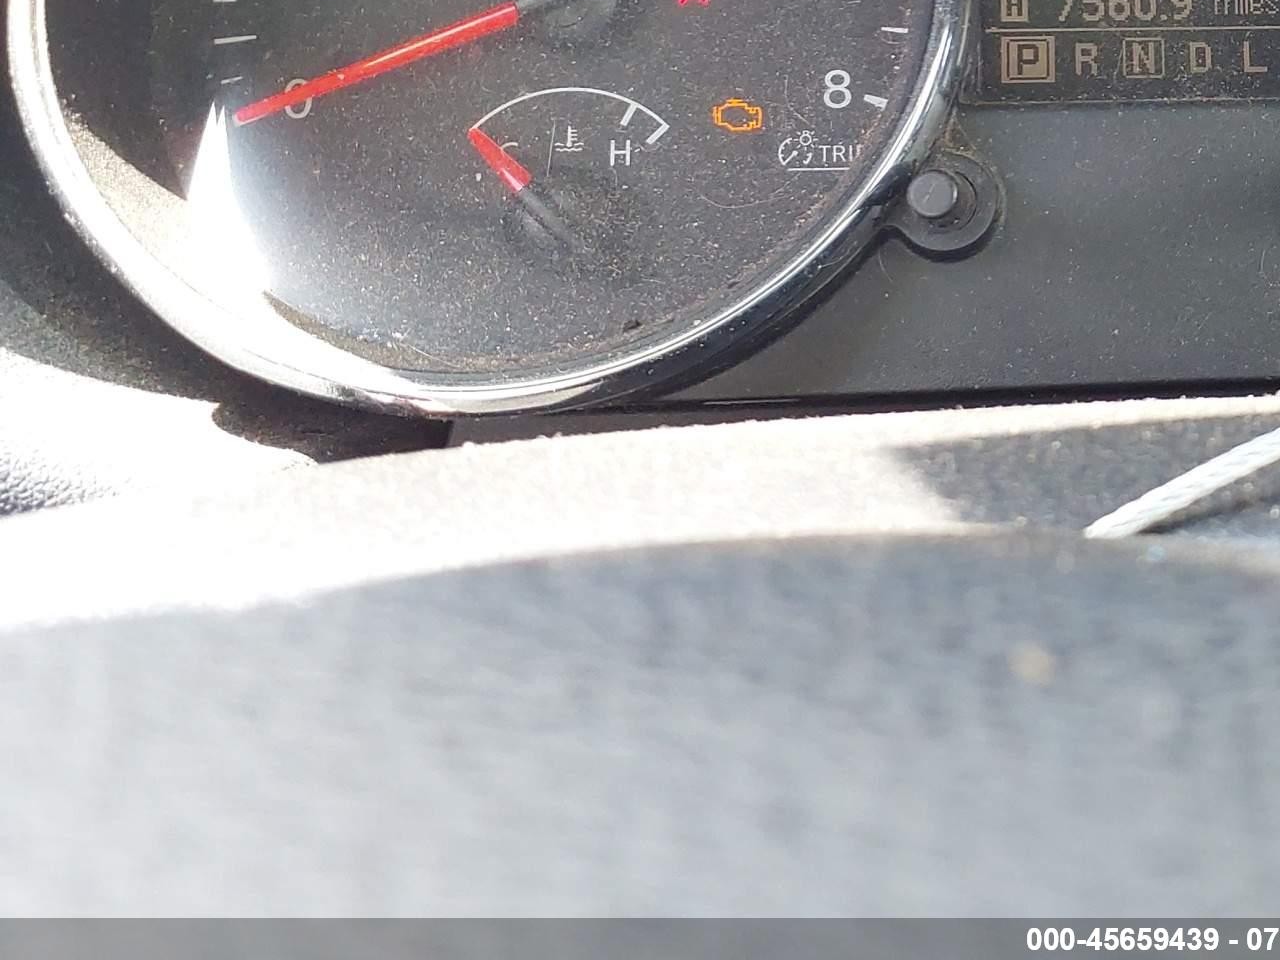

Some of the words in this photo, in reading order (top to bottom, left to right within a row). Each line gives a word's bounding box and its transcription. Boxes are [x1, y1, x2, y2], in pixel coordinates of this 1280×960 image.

[1016, 43, 1041, 76] P
[1075, 42, 1099, 75] R
[1132, 42, 1155, 74] N
[1189, 41, 1212, 73] D
[1243, 40, 1268, 73] L
[823, 69, 852, 109] 8
[610, 139, 631, 166] H
